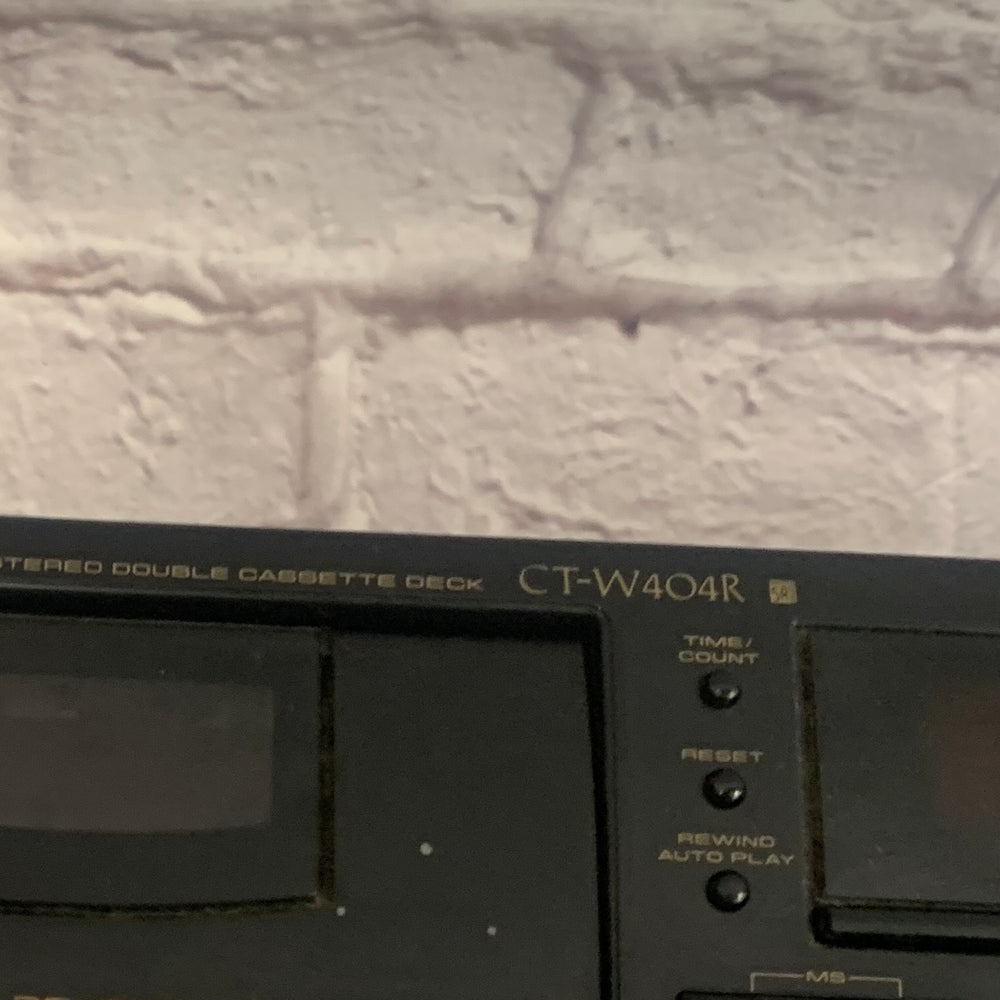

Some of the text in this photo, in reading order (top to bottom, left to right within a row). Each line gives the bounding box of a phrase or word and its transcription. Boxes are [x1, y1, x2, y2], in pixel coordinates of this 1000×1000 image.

[111, 561, 230, 582] DOUBLE
[237, 566, 397, 588] CASSETTE
[405, 574, 485, 592] DECK
[518, 563, 745, 603] CT-W404R
[677, 650, 761, 665] COUNT
[681, 748, 764, 764] RESET
[676, 832, 776, 849] REWIND
[656, 850, 796, 866] AUTO PLAY
[805, 970, 847, 985] MS
